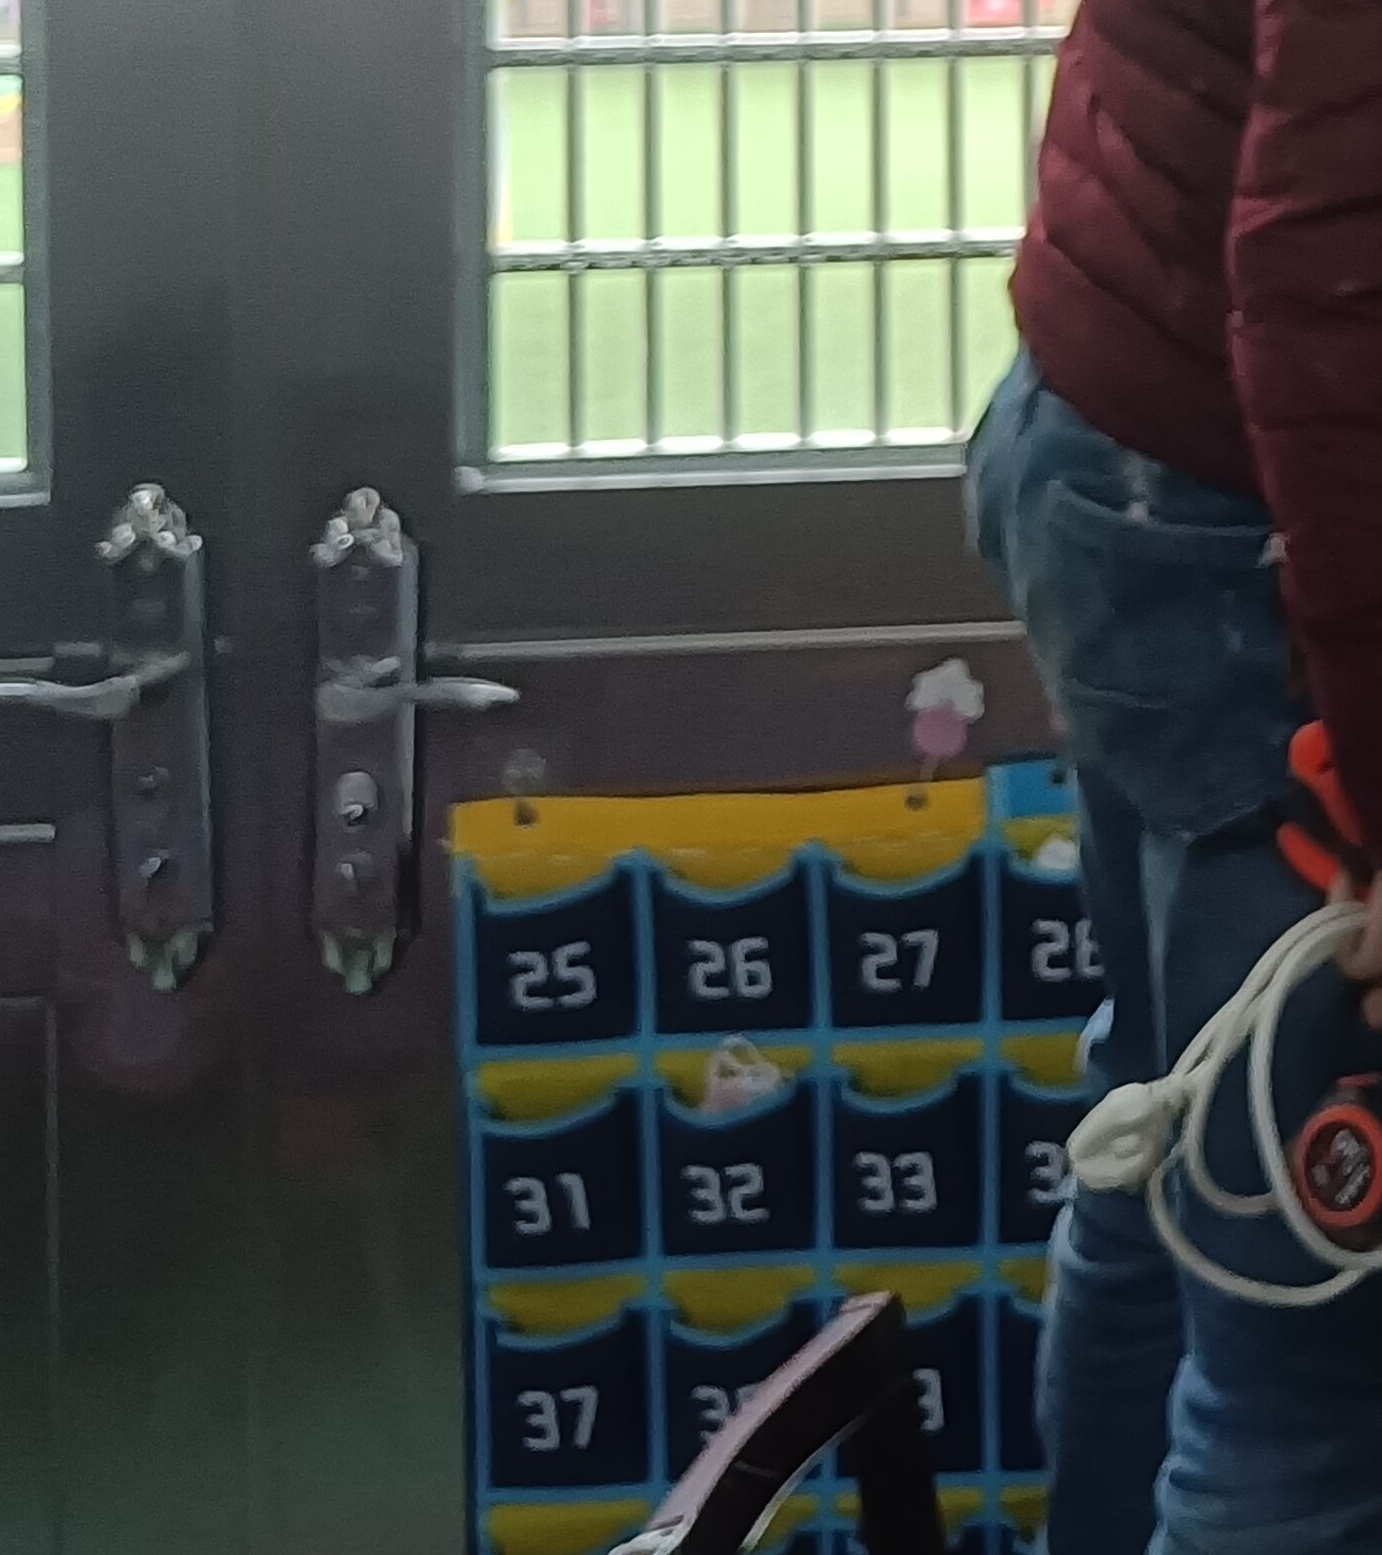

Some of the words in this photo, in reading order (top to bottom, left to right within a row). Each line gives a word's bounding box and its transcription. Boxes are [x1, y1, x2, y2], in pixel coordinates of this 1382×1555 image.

[507, 940, 598, 1012] 25
[687, 936, 773, 1000] 26
[859, 929, 940, 993] 27
[504, 1172, 592, 1235] 31
[681, 1162, 770, 1225] 32
[854, 1150, 938, 1214] 33
[517, 1385, 600, 1452] 37
